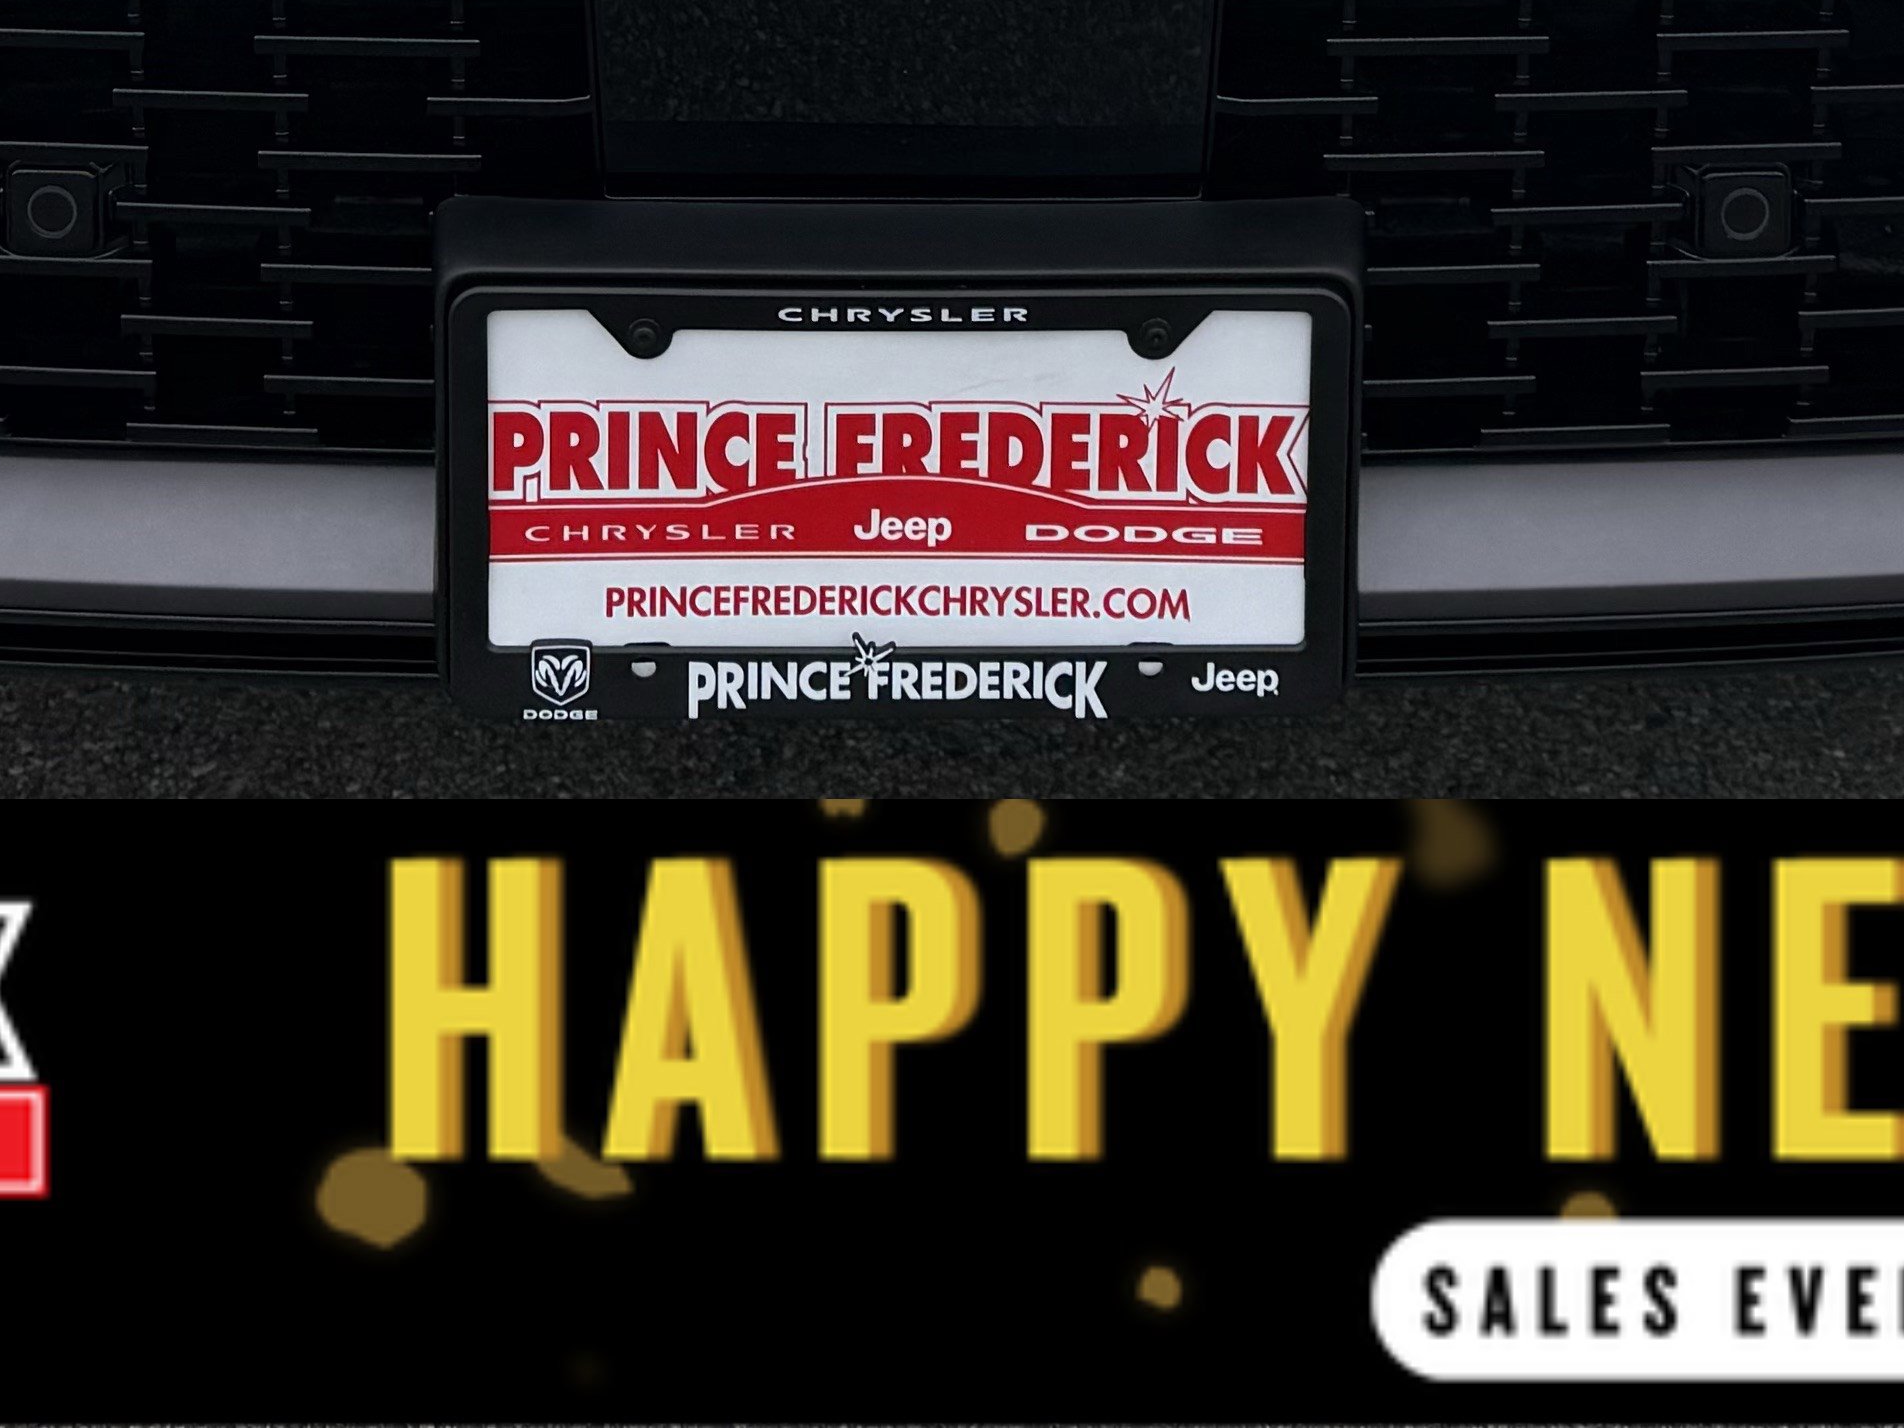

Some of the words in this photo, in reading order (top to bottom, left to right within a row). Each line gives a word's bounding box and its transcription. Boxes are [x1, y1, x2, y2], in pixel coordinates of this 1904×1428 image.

[777, 306, 1029, 324] CHRYSLER
[490, 402, 807, 497] PRINCE
[826, 402, 1304, 501] FREDERICK
[524, 523, 797, 543] CHRYSLER
[852, 507, 953, 545] Jeep
[1024, 523, 1264, 546] DODGE
[604, 584, 1191, 622] PRINCEFREDERICKCHRYSLER.COM
[688, 660, 853, 720] PRINCE
[866, 660, 1109, 720] FREDERICK
[1191, 661, 1280, 699] Jeep
[522, 708, 599, 722] DODGE
